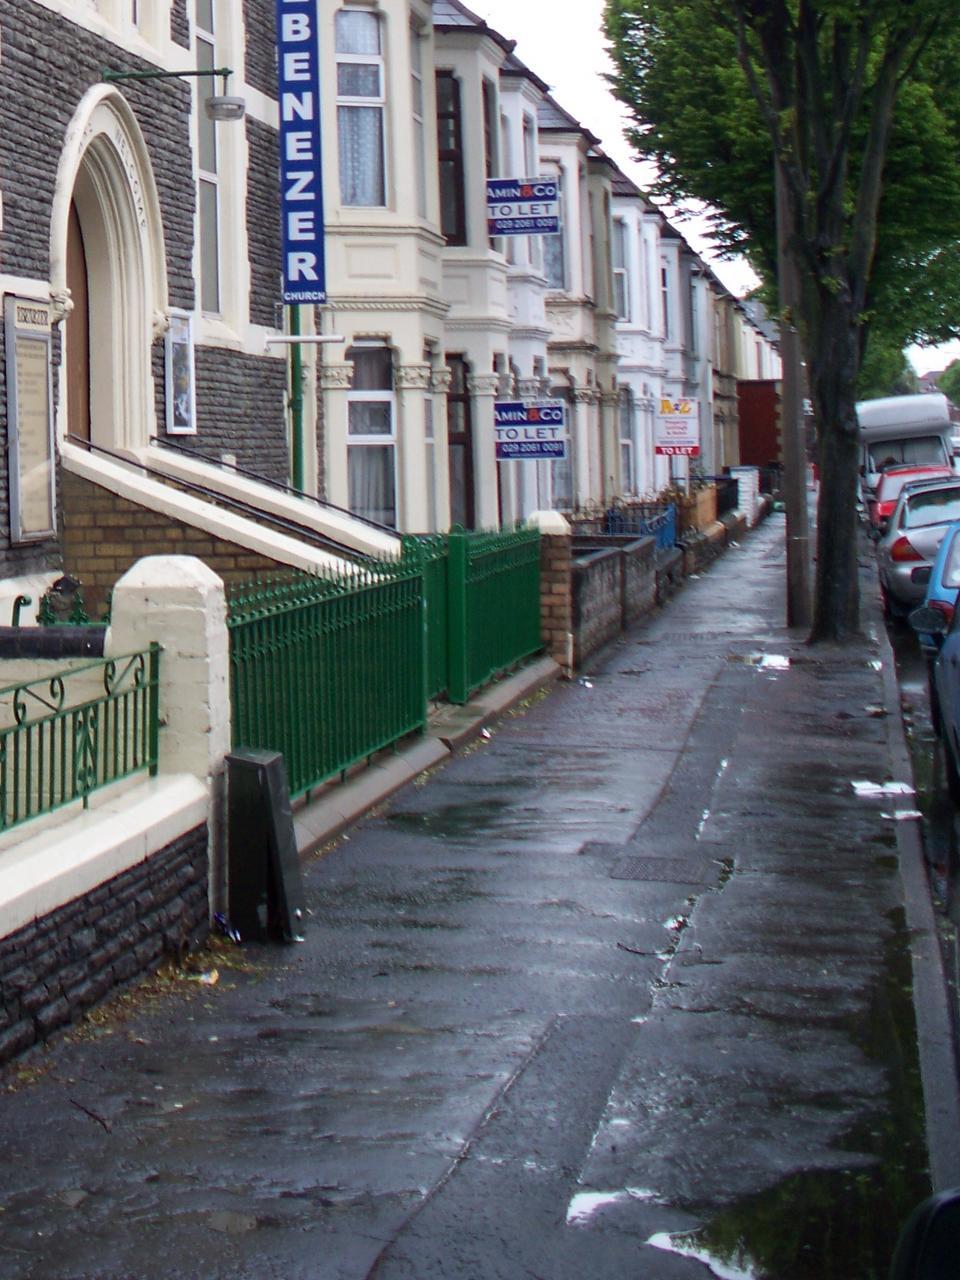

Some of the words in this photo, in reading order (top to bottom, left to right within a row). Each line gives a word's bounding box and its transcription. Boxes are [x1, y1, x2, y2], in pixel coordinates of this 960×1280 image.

[488, 205, 512, 216] TO
[518, 203, 552, 216] LET
[284, 291, 326, 300] CHURCH
[495, 428, 518, 440] TO
[524, 427, 559, 439] LET
[661, 447, 674, 455] TO
[676, 447, 693, 455] LET
